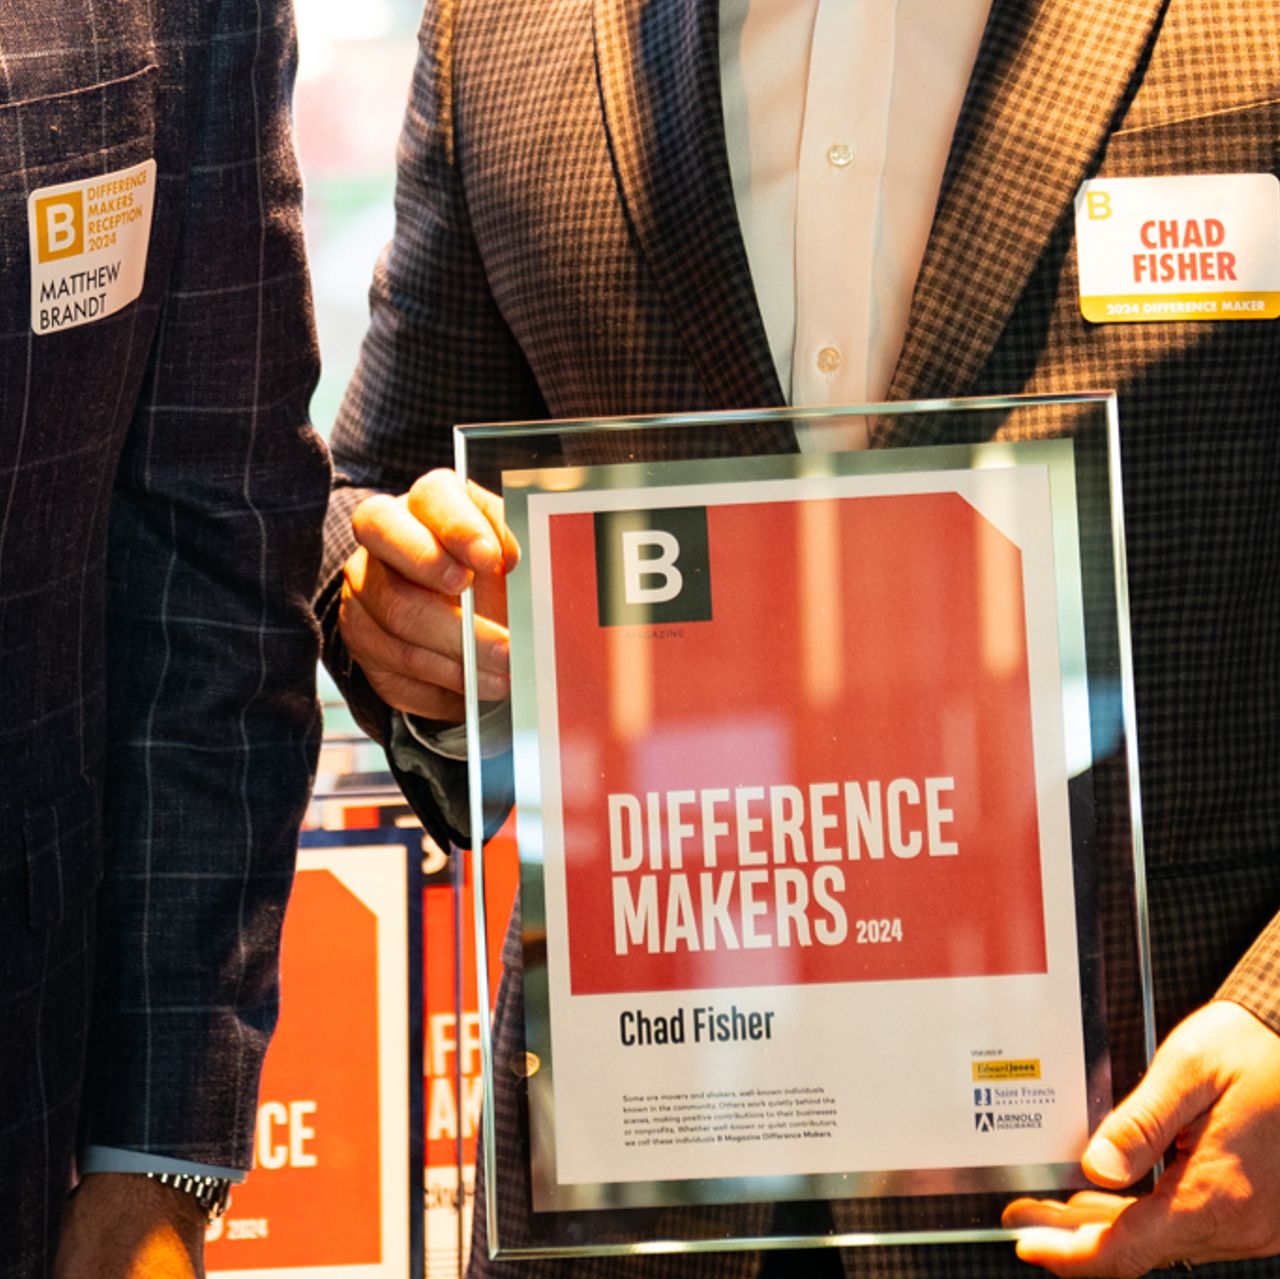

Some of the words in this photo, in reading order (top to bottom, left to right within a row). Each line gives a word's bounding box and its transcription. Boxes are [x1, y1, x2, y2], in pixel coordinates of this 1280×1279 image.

[87, 171, 147, 201] DIFFERENCE
[88, 192, 134, 218] MAKERS
[88, 205, 143, 236] RECEPTION
[1086, 190, 1113, 221] B
[45, 202, 76, 254] B
[88, 233, 117, 252] 2024
[1140, 218, 1226, 250] CHAD
[40, 261, 122, 303] MATTHEW
[1133, 251, 1237, 283] FISHER
[40, 293, 107, 331] BRANDT
[1106, 303, 1139, 316] 2024
[1143, 301, 1217, 314] DIFFERENCE
[1221, 300, 1265, 312] MAKER
[622, 530, 683, 604] B
[608, 776, 959, 872] DIFFERENCE
[612, 865, 849, 956] MAKERS
[855, 918, 904, 945] 2024
[620, 1007, 685, 1047] Chad
[693, 1005, 775, 1044] Fisher
[997, 1113, 1043, 1123] ARNOLD
[258, 1100, 318, 1170] CE
